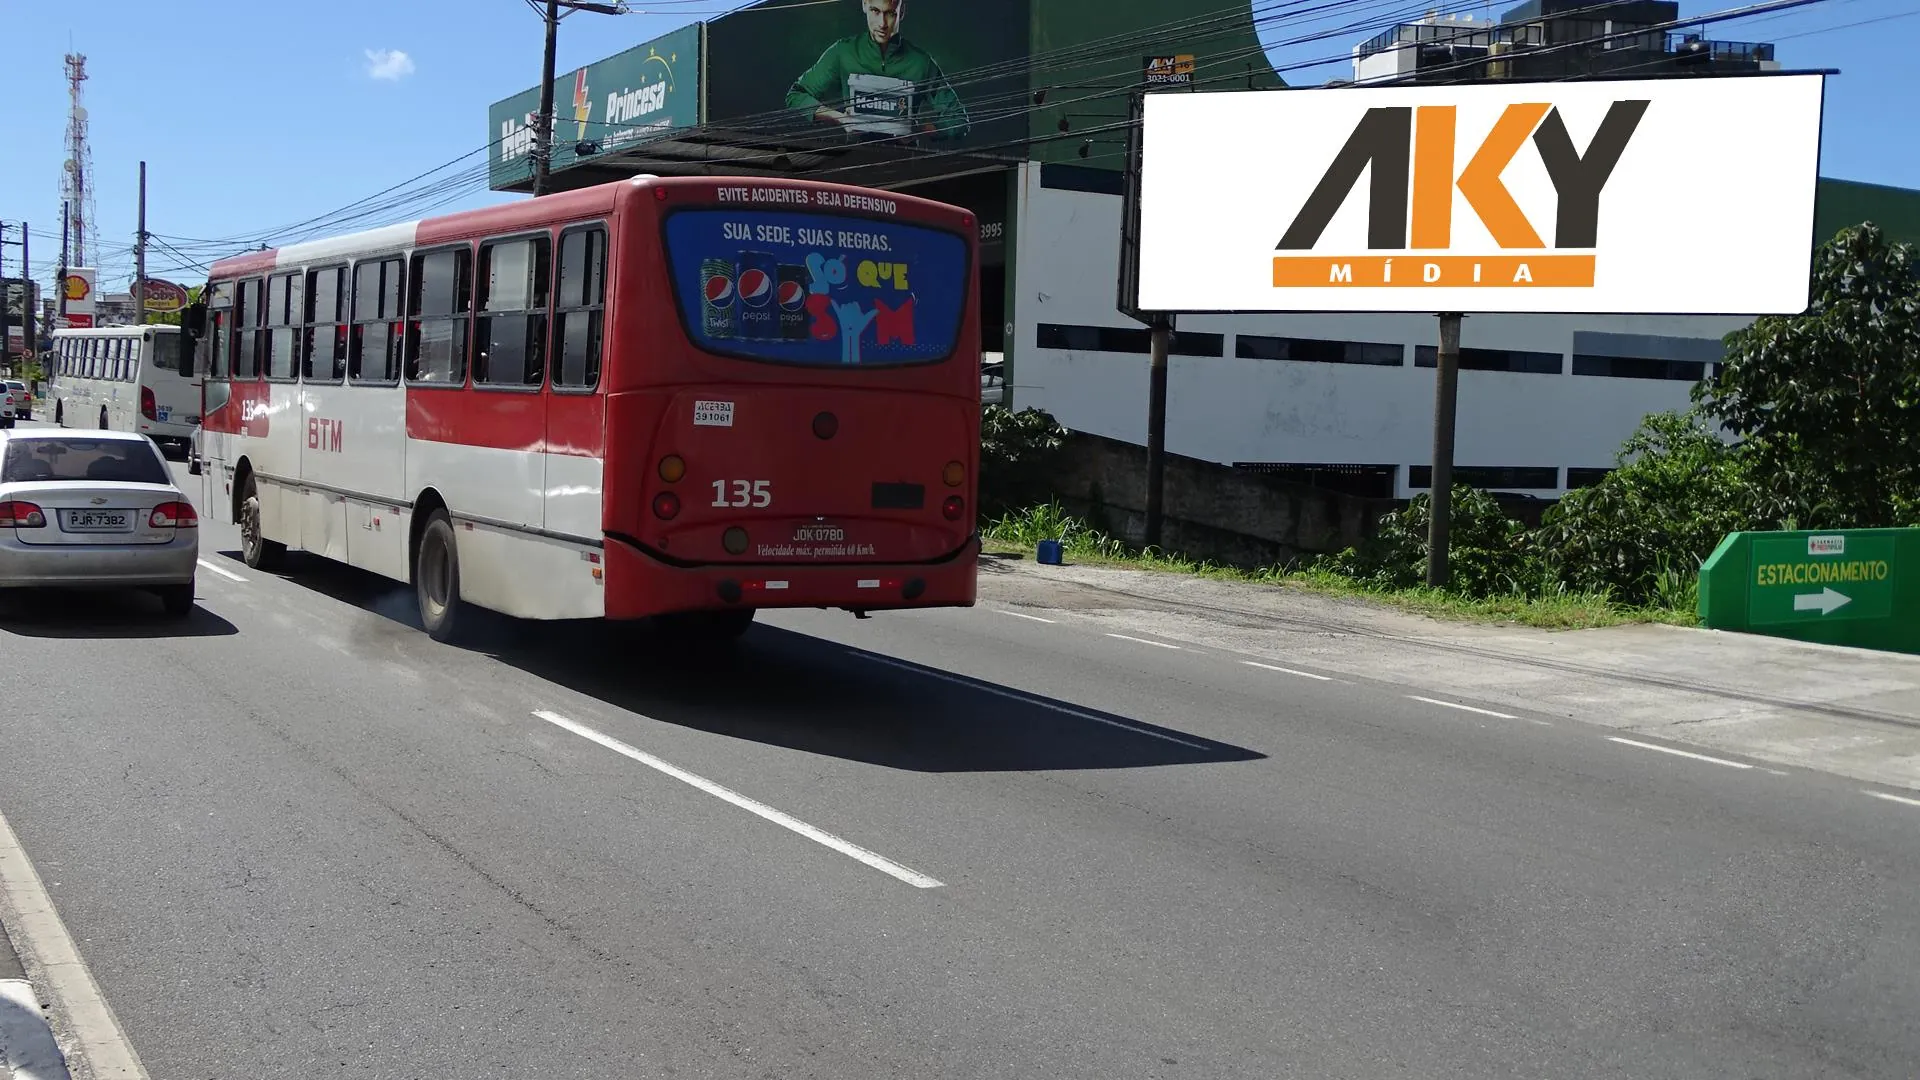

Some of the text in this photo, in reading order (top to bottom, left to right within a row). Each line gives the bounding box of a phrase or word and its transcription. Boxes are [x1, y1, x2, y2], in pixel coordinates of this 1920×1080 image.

[605, 81, 666, 127] Princesa
[1275, 100, 1652, 250] AKY
[718, 187, 750, 202] EVITE
[751, 188, 809, 204] ACIDENTES
[816, 191, 841, 207] SEJA
[843, 194, 897, 214] DEFENSIVO
[723, 222, 892, 252] SUA SEDE, SUAS REGRAS.
[856, 259, 909, 290] QUE
[1329, 258, 1533, 283] MÍDIA
[742, 311, 770, 323] pepsi
[695, 412, 730, 421] 391061
[308, 417, 343, 453] BTM
[711, 480, 771, 508] 135
[757, 544, 795, 557] Velocidade
[1757, 560, 1888, 585] ESTACIONAMENTO
